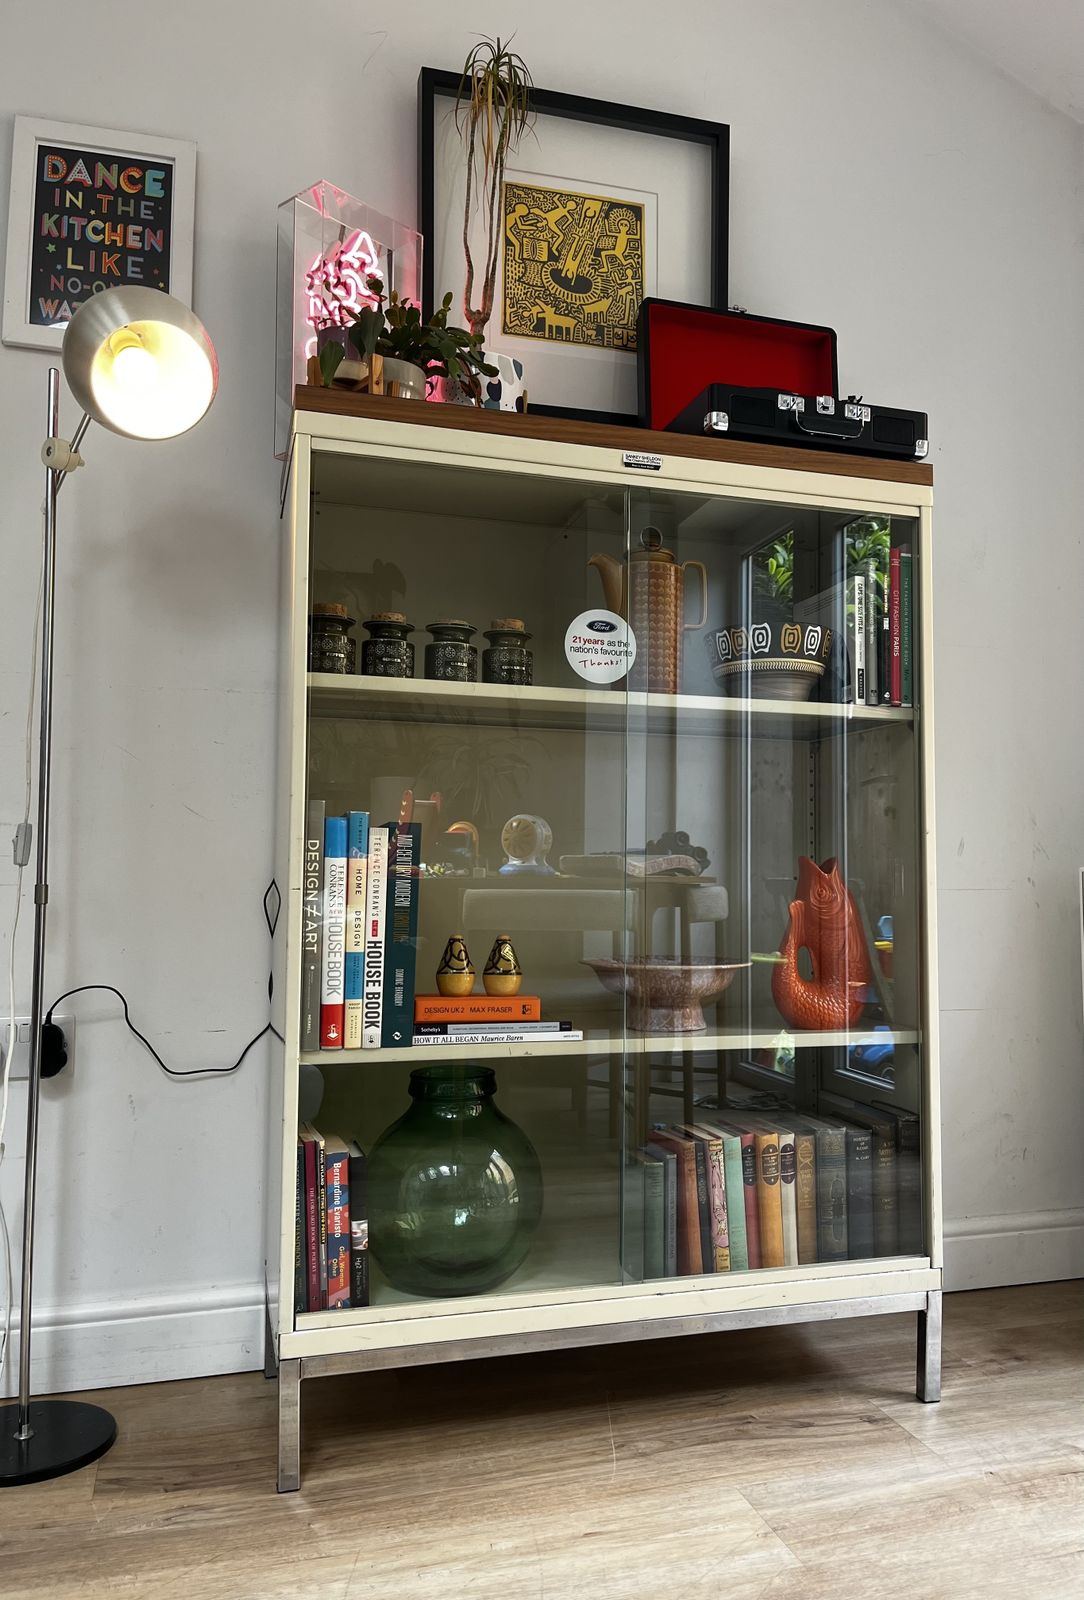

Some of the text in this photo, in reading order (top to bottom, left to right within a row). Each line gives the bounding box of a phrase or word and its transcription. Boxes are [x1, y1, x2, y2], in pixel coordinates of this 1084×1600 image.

[44, 154, 165, 198] DANCE
[54, 188, 154, 220] IN THE
[40, 212, 164, 252] KITCHEN
[66, 248, 144, 280] LIKE
[570, 646, 632, 657] nation's favourite
[582, 638, 605, 646] years
[307, 840, 319, 900] DESIGN
[373, 837, 381, 874] TERENCE
[329, 864, 337, 907] CONRAN'S
[371, 879, 381, 917] CONRAN'S
[393, 834, 413, 943] MID-CENTURY MODERN FURNITURE
[305, 921, 318, 953] ART
[328, 916, 342, 958] HOUSE
[327, 962, 341, 996] BOOK
[366, 941, 382, 987] HOUSE
[365, 992, 381, 1029] BOOK
[333, 1162, 342, 1238] Bernardine Evaristo
